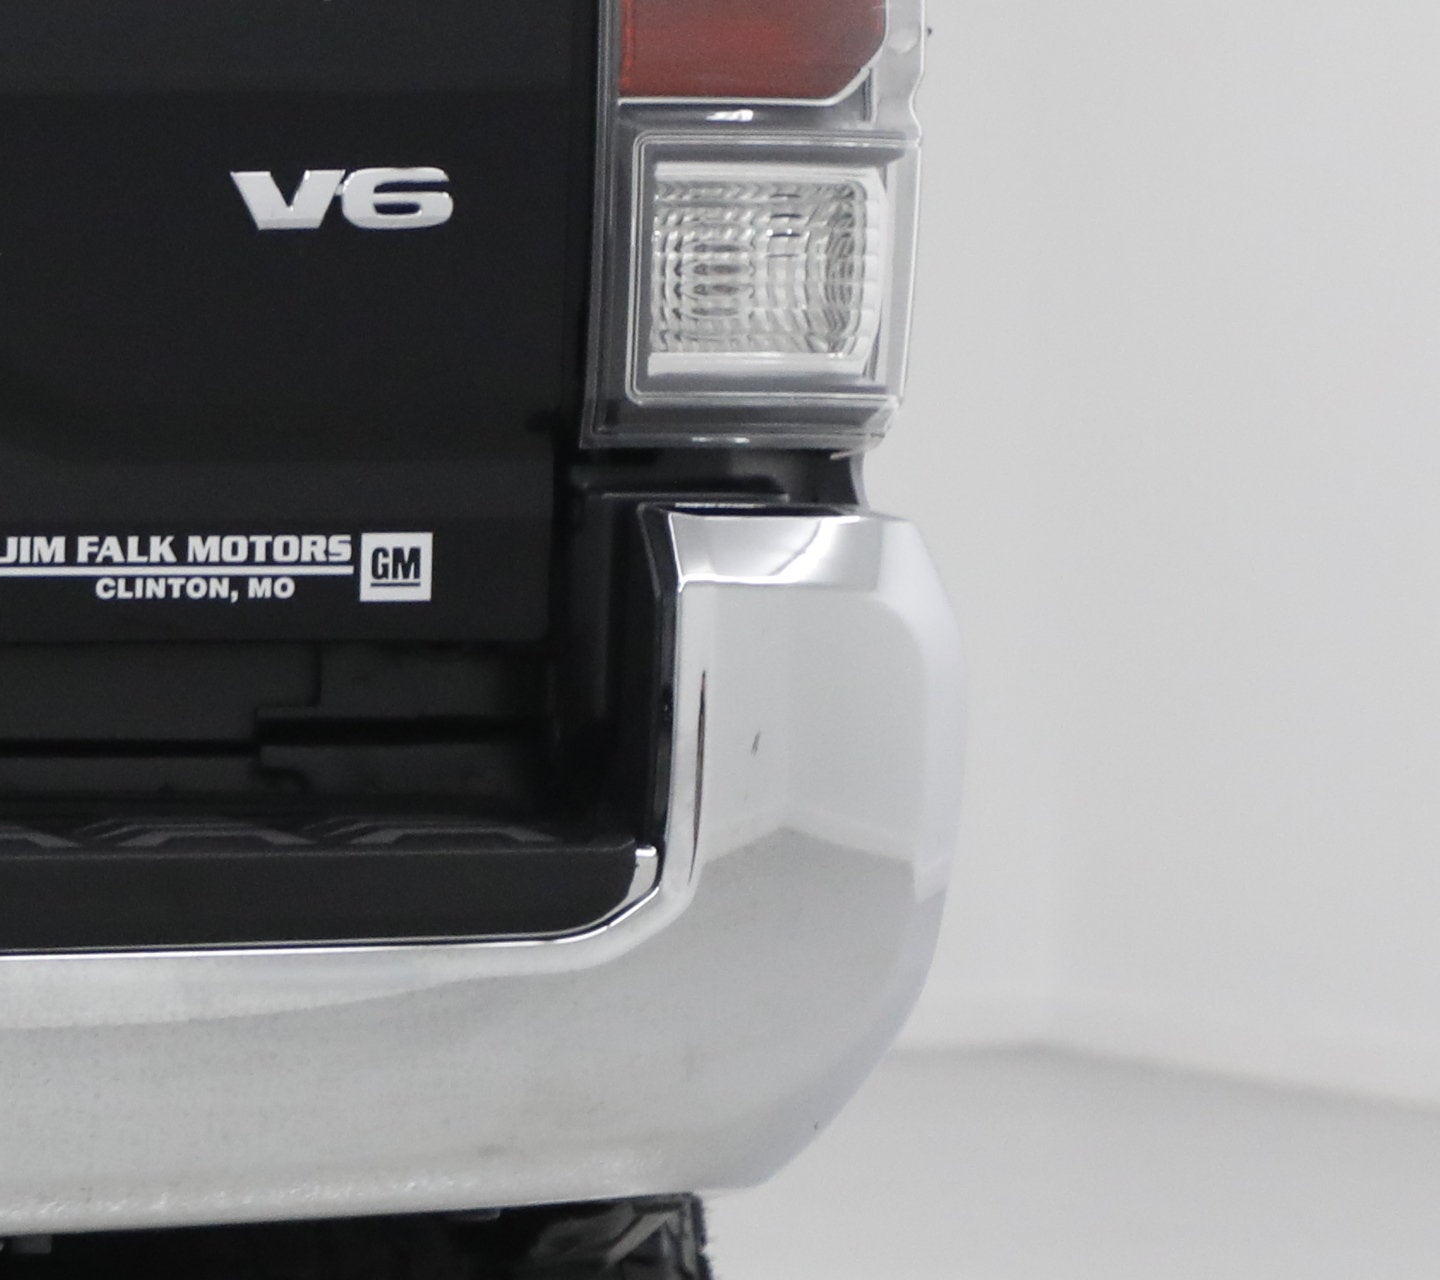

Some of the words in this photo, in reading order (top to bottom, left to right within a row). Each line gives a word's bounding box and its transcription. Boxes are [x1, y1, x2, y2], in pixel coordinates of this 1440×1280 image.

[230, 166, 454, 230] V6
[77, 535, 177, 563] FALK
[187, 534, 352, 563] MOTORS
[371, 546, 421, 581] GM
[95, 576, 239, 603] CLINTON,
[248, 575, 295, 599] MO
